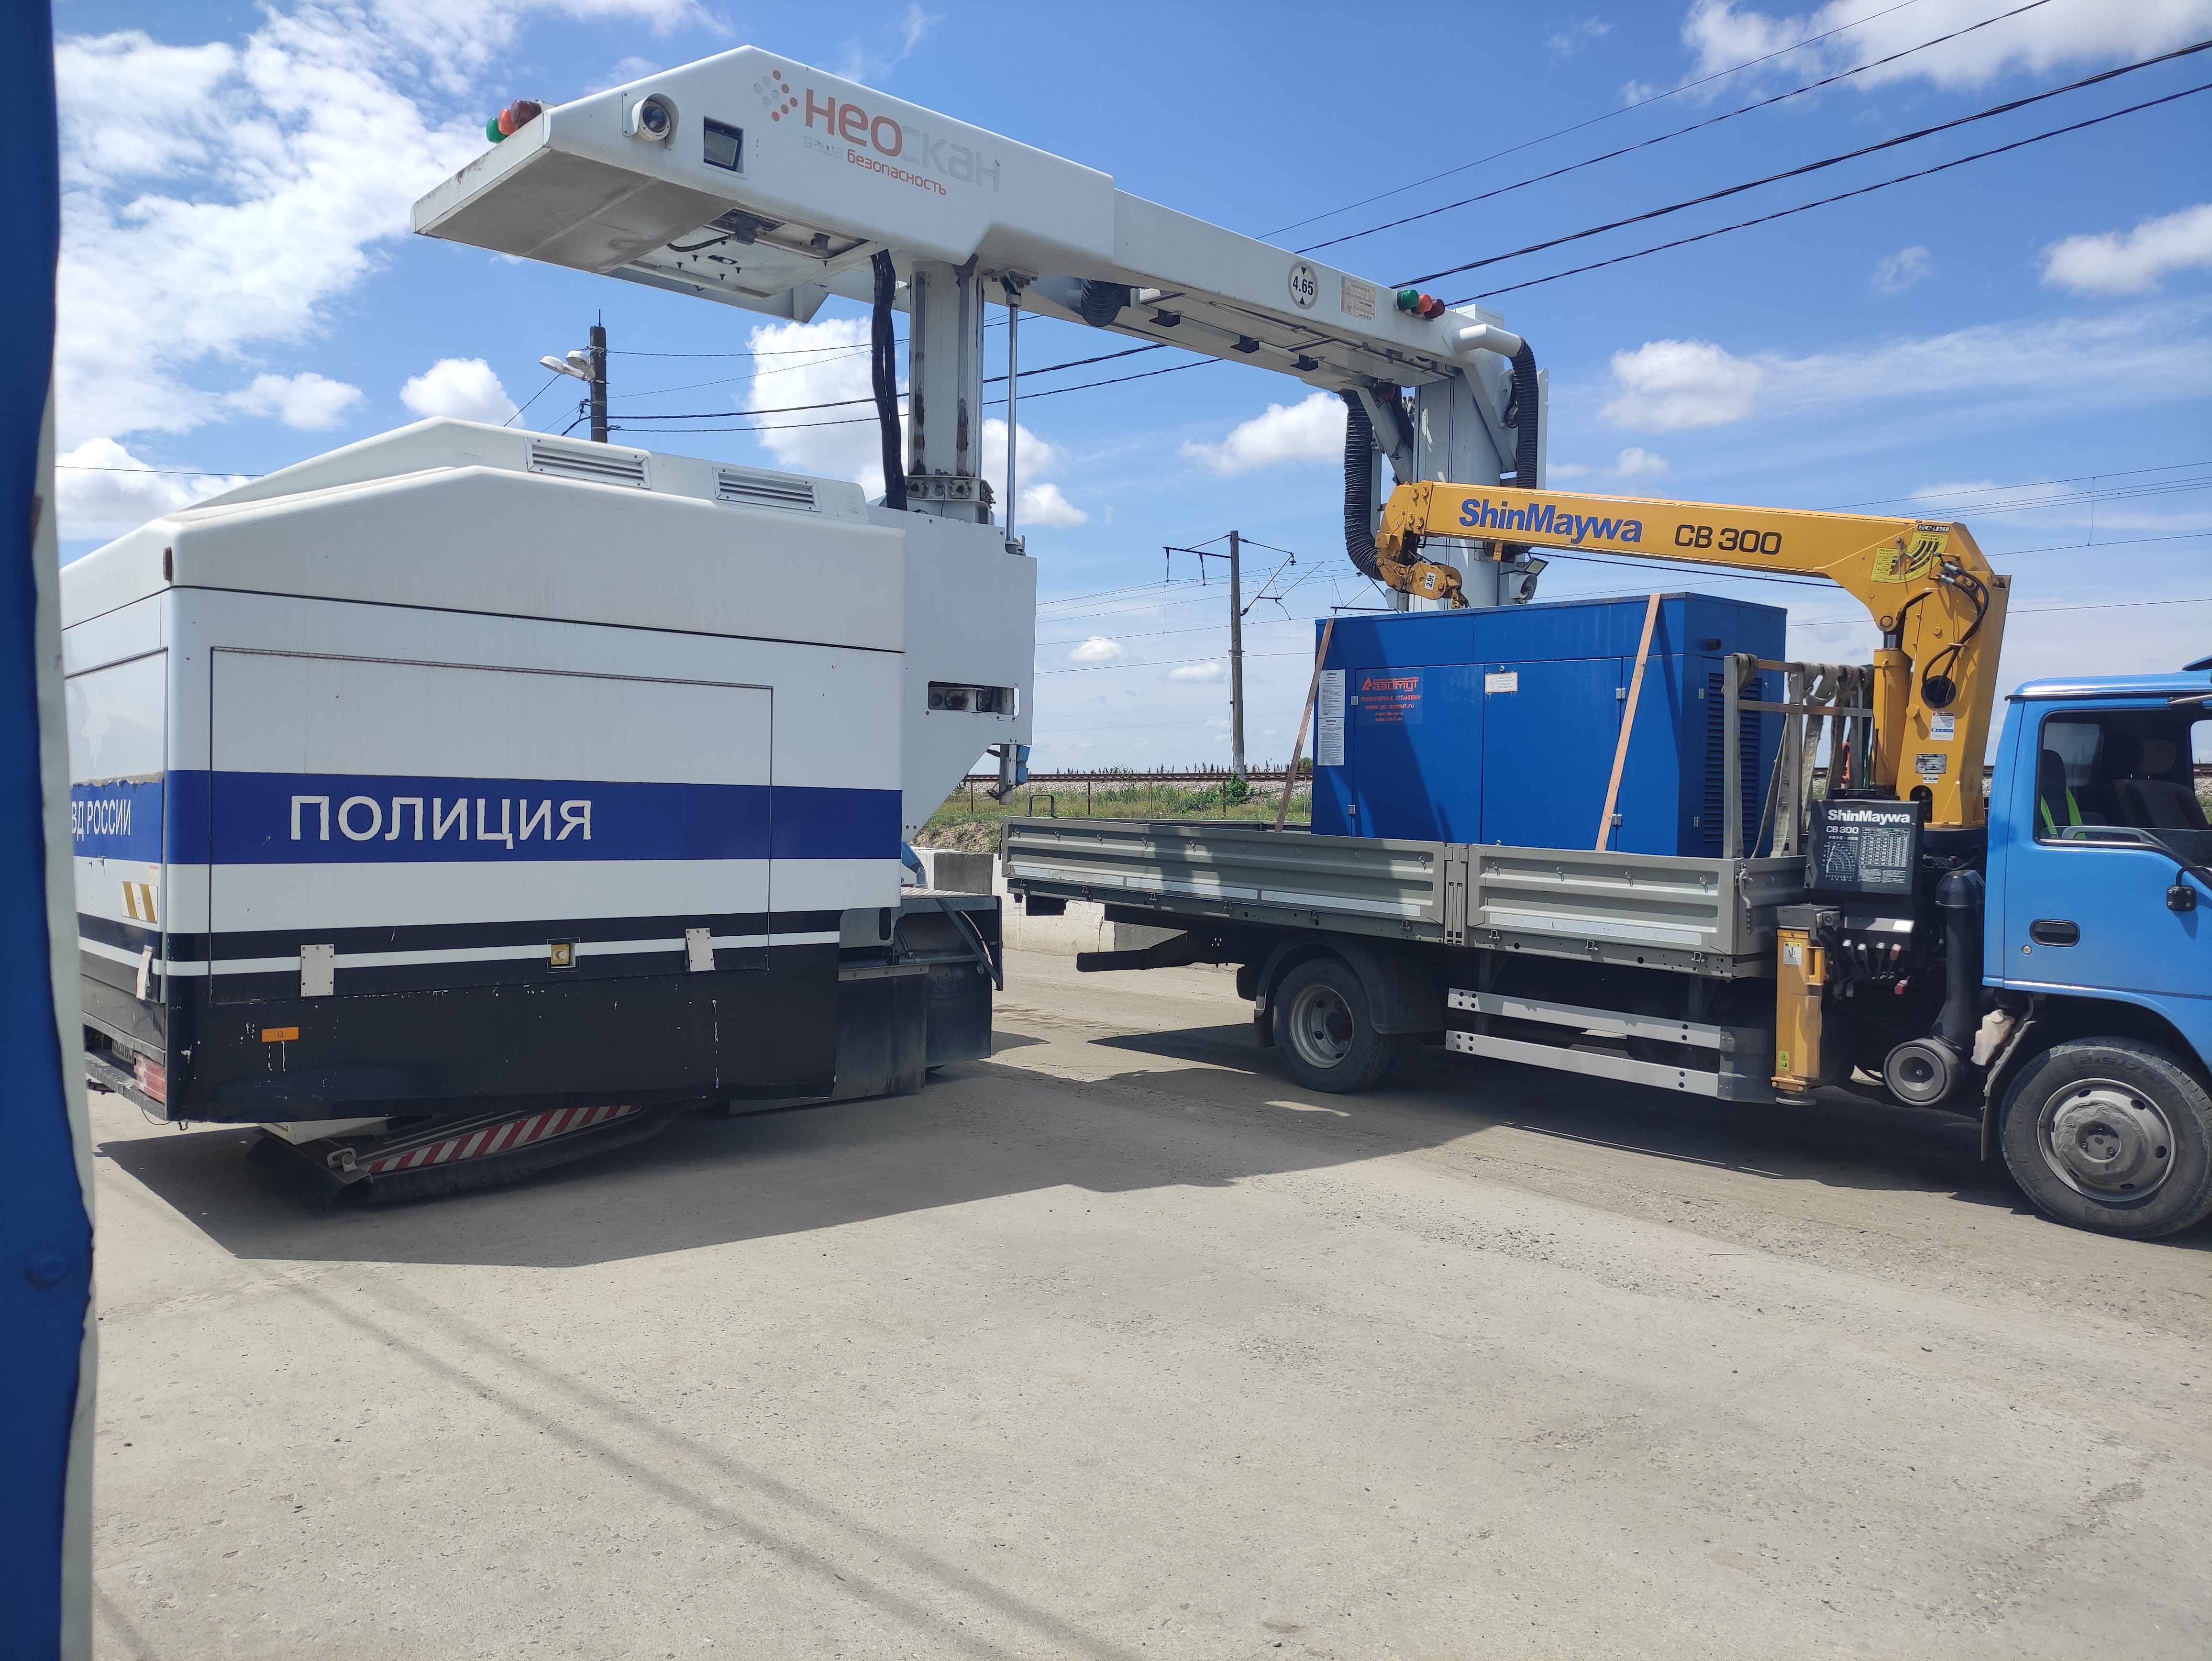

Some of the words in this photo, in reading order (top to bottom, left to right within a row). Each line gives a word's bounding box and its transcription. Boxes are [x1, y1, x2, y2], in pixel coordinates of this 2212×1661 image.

[847, 149, 947, 196] безопасность
[1293, 276, 1314, 296] 4.65
[1459, 498, 1642, 544] ShinMaywa
[1675, 524, 1712, 549] CB
[1718, 528, 1782, 555] 300
[1426, 575, 1434, 588] 2,9t
[71, 800, 84, 842] ВД
[87, 798, 131, 836] РОССИИ
[290, 795, 592, 850] ПОЛИЦИЯ
[1826, 825, 1838, 833] CB
[1839, 826, 1859, 834] 300
[1827, 809, 1910, 825] ShinMaywa
